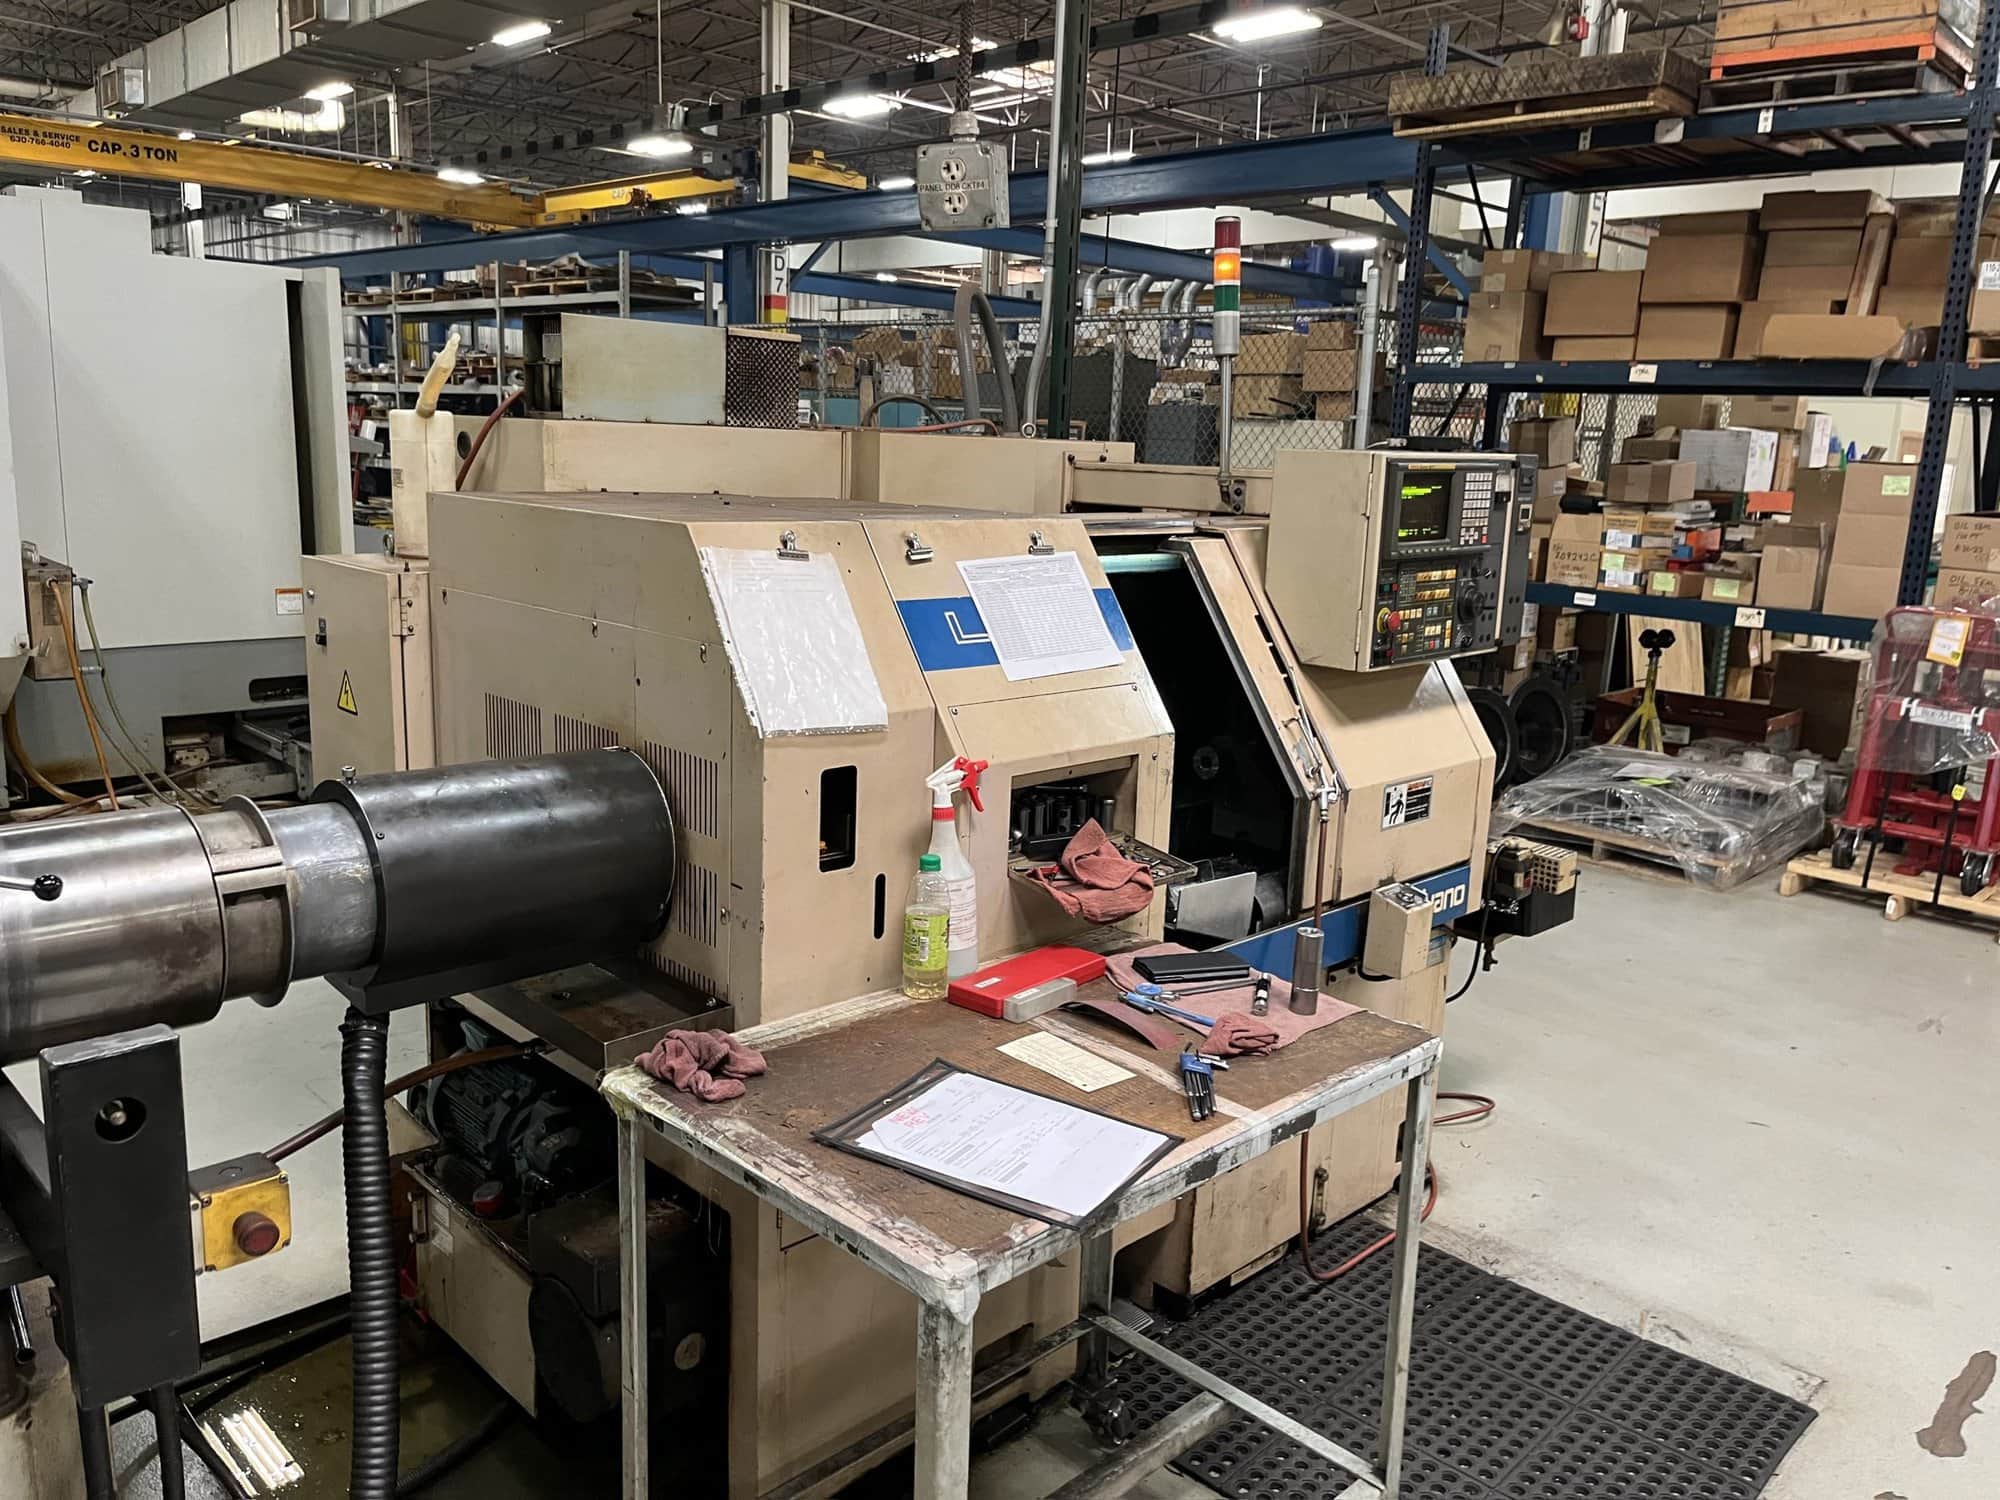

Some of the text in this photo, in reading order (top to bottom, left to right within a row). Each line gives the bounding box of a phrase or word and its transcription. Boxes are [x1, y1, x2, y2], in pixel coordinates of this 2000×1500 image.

[0, 125, 81, 142] SALES & SERVICE
[88, 140, 178, 162] CAP. 3 TON
[919, 183, 943, 192] PANEL
[1430, 884, 1465, 913] ano
